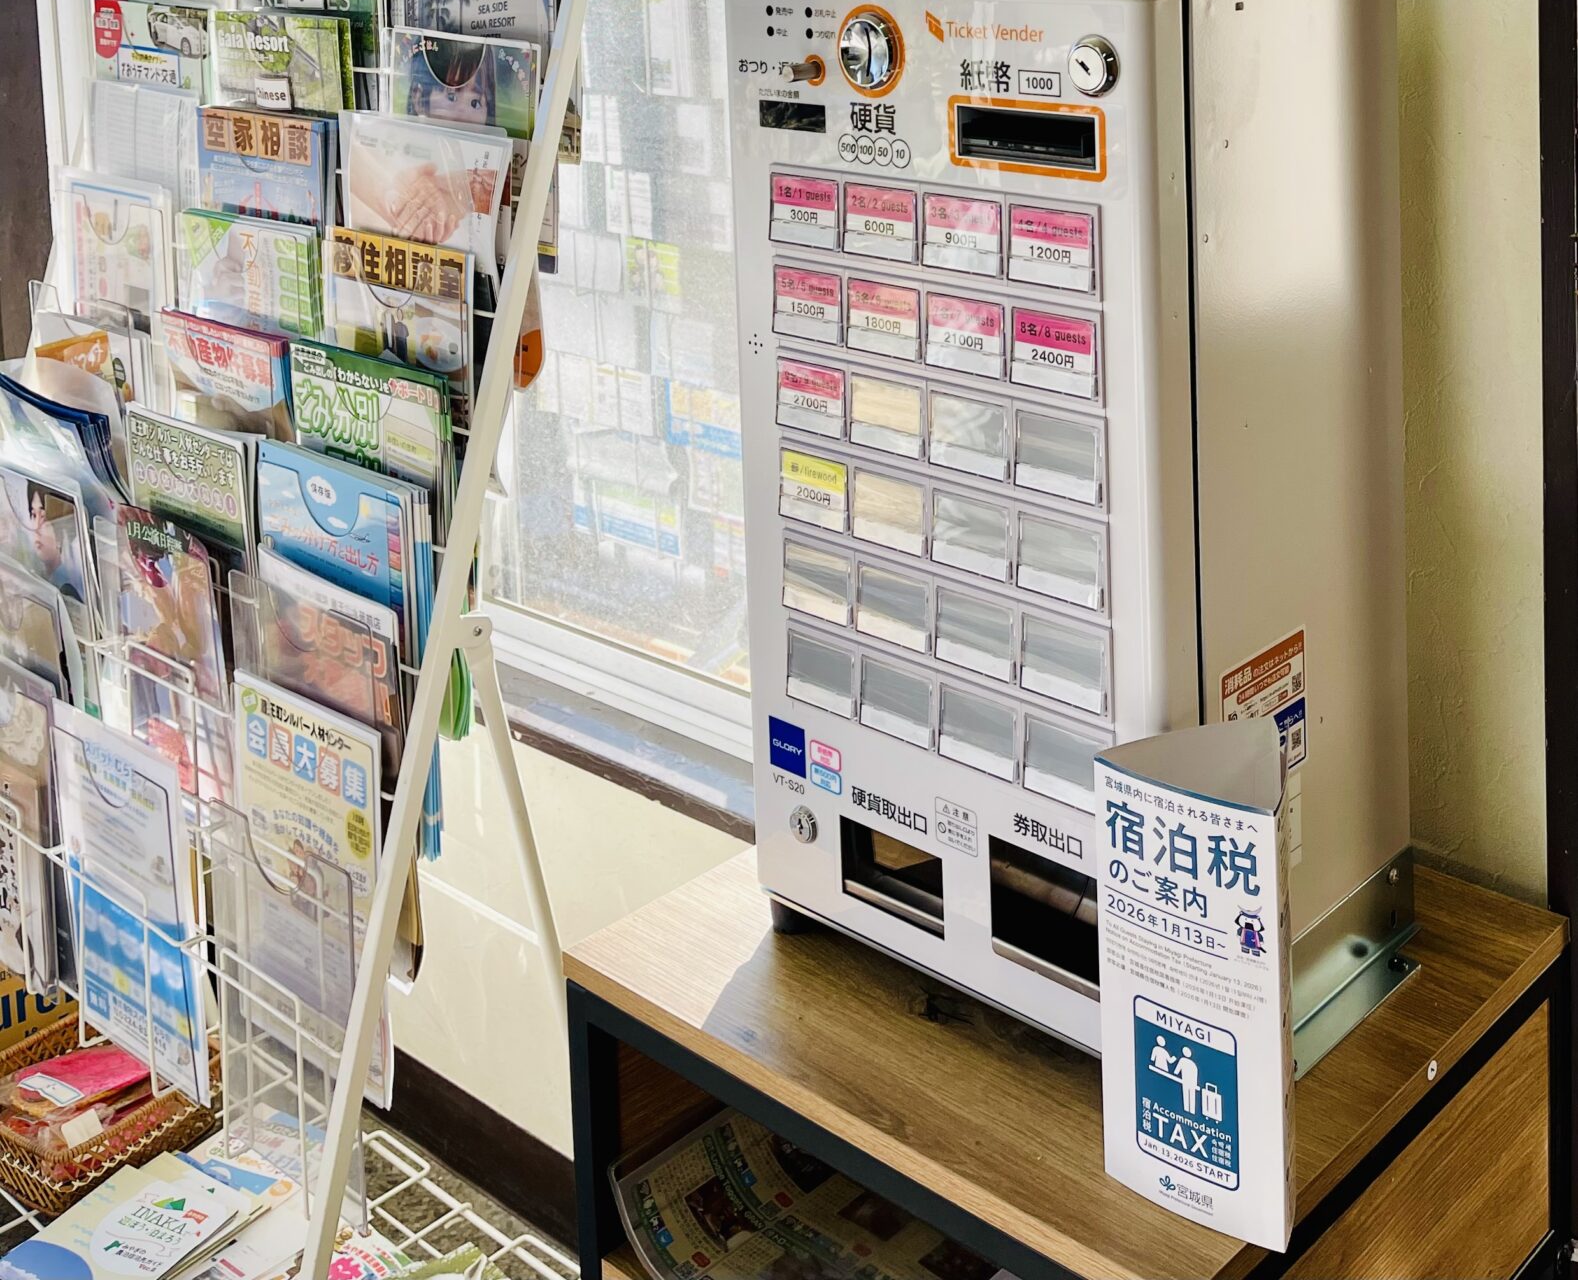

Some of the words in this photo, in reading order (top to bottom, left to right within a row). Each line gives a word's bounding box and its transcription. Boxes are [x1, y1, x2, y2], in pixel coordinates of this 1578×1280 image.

[478, 3, 491, 15] SEA
[492, 1, 508, 12] SIDE
[775, 6, 794, 16] 発売中
[471, 19, 487, 30] GAIA
[488, 16, 516, 28] RESORT
[776, 28, 788, 37] 中止
[947, 22, 989, 40] Ticket
[993, 24, 1045, 43] Vender
[218, 28, 245, 49] Gaia
[247, 31, 289, 53] Resort
[959, 59, 1012, 93] 紙幣
[1025, 76, 1054, 92] 1000
[255, 87, 287, 102] Chinese
[850, 101, 897, 135] 硬貨
[204, 113, 312, 163] 空家相談
[840, 141, 856, 154] 500
[859, 143, 873, 156] 100
[876, 144, 889, 158] 50
[894, 147, 906, 160] 10
[778, 186, 802, 199] 1名/1
[805, 189, 832, 202] guests
[851, 194, 878, 209] 2名/2
[881, 200, 908, 214] guests
[790, 209, 818, 224] 300円
[864, 220, 895, 235] 600円
[945, 232, 977, 248] 900円
[1051, 224, 1084, 240] guests
[1029, 245, 1071, 264] 1200円
[333, 234, 464, 299] 移住相談室
[791, 302, 825, 318] 1500円
[865, 316, 901, 334] 1800円
[1020, 322, 1051, 337] 8名/8
[1055, 328, 1087, 345] guests
[944, 332, 983, 350] 2100円
[1031, 349, 1074, 369] 2400円
[295, 378, 380, 450] ごみ分別
[794, 395, 828, 413] 2700円
[310, 483, 332, 499] 保存版
[797, 486, 831, 506] 2000円
[260, 698, 351, 751] 蔵王町シルバー人材センター
[772, 738, 803, 756] GLORY
[248, 718, 365, 805] 会員大募集
[773, 772, 805, 795] VT-S20
[851, 785, 928, 835] 硬貨取出口
[1104, 775, 1258, 833] 宮城県内に宿泊される皆さまへ
[1013, 812, 1084, 860] 券取出口
[1105, 799, 1261, 897] 宿泊税
[1109, 858, 1208, 919] のご案内
[1157, 1010, 1211, 1043] MIYAGI
[1142, 1097, 1152, 1132] 宿泊税
[1152, 1102, 1232, 1142] Accommodation
[1152, 1112, 1209, 1158] TAX
[1174, 1150, 1194, 1168] 2026
[1196, 1162, 1231, 1183] START
[1176, 1183, 1214, 1211] 宮城県
[131, 1206, 187, 1235] INAKA
